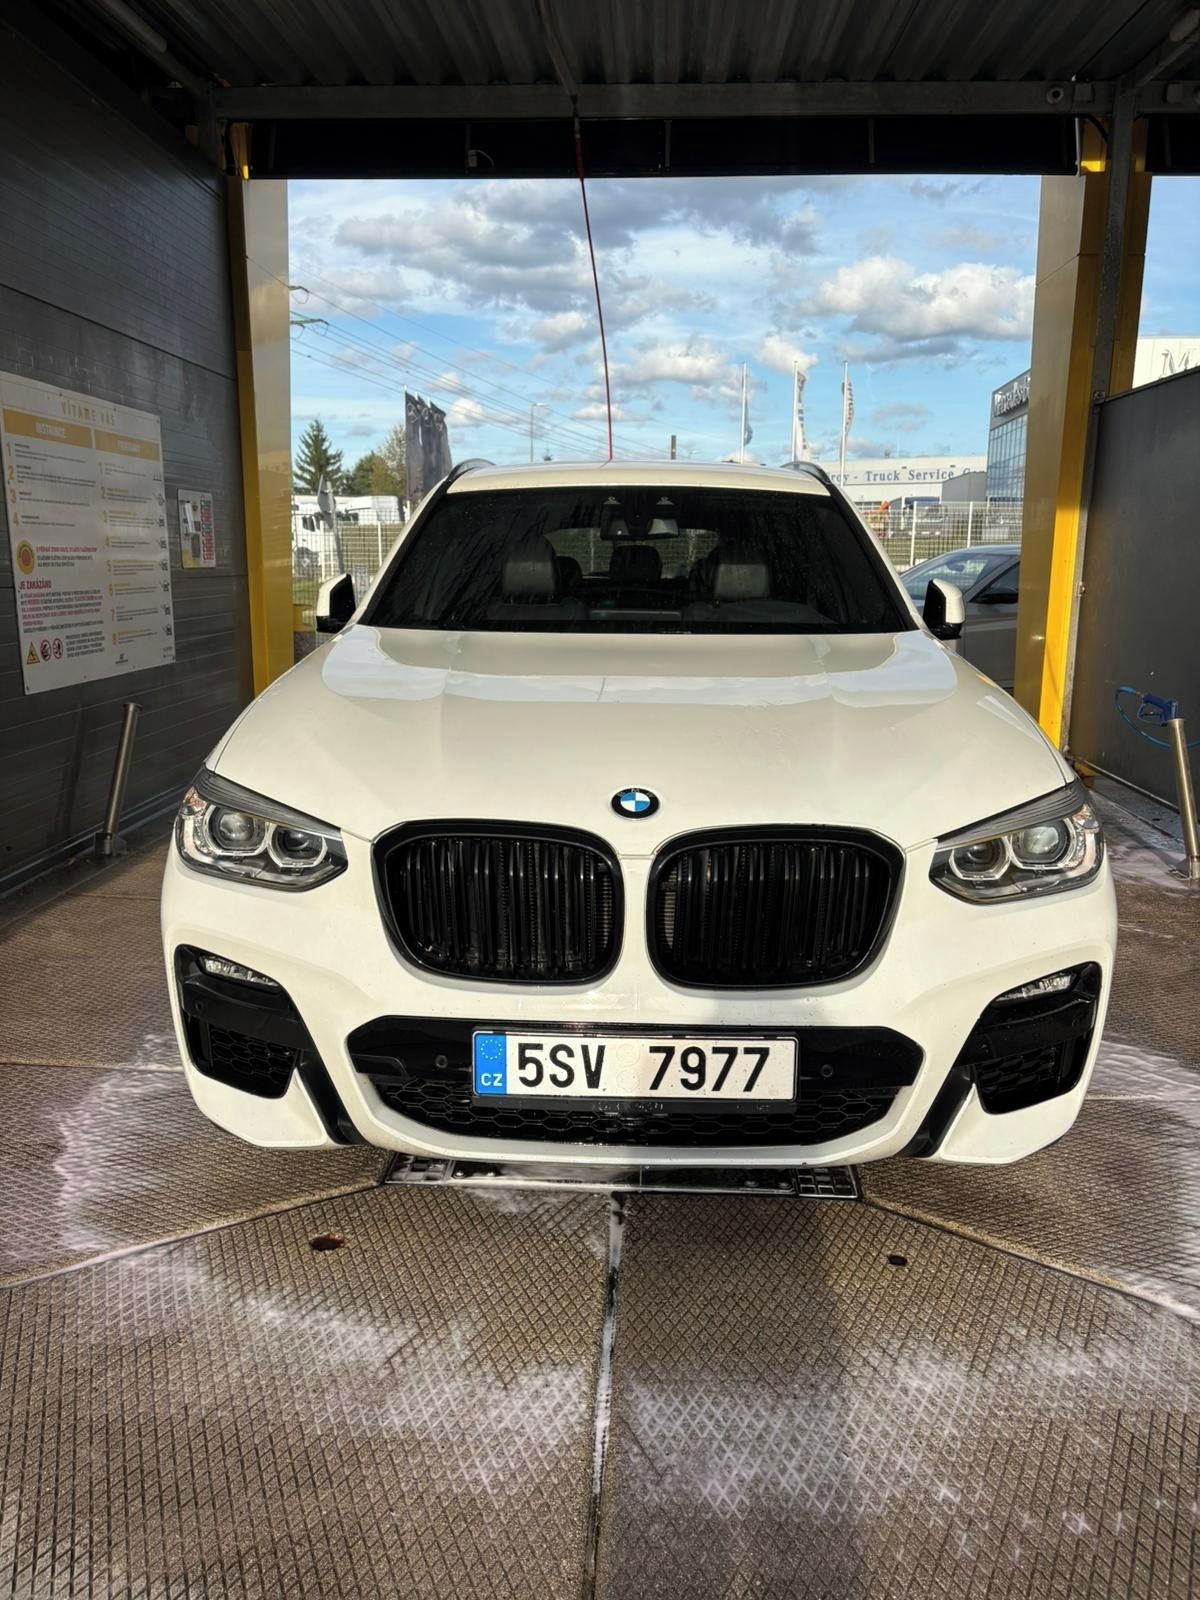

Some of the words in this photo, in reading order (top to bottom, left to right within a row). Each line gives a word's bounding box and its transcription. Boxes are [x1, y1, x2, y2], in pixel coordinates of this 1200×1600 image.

[864, 470, 901, 482] Truck
[908, 468, 955, 481] Service
[518, 1043, 606, 1089] 5SV
[649, 1046, 770, 1092] 7977
[480, 1072, 503, 1087] CZ
